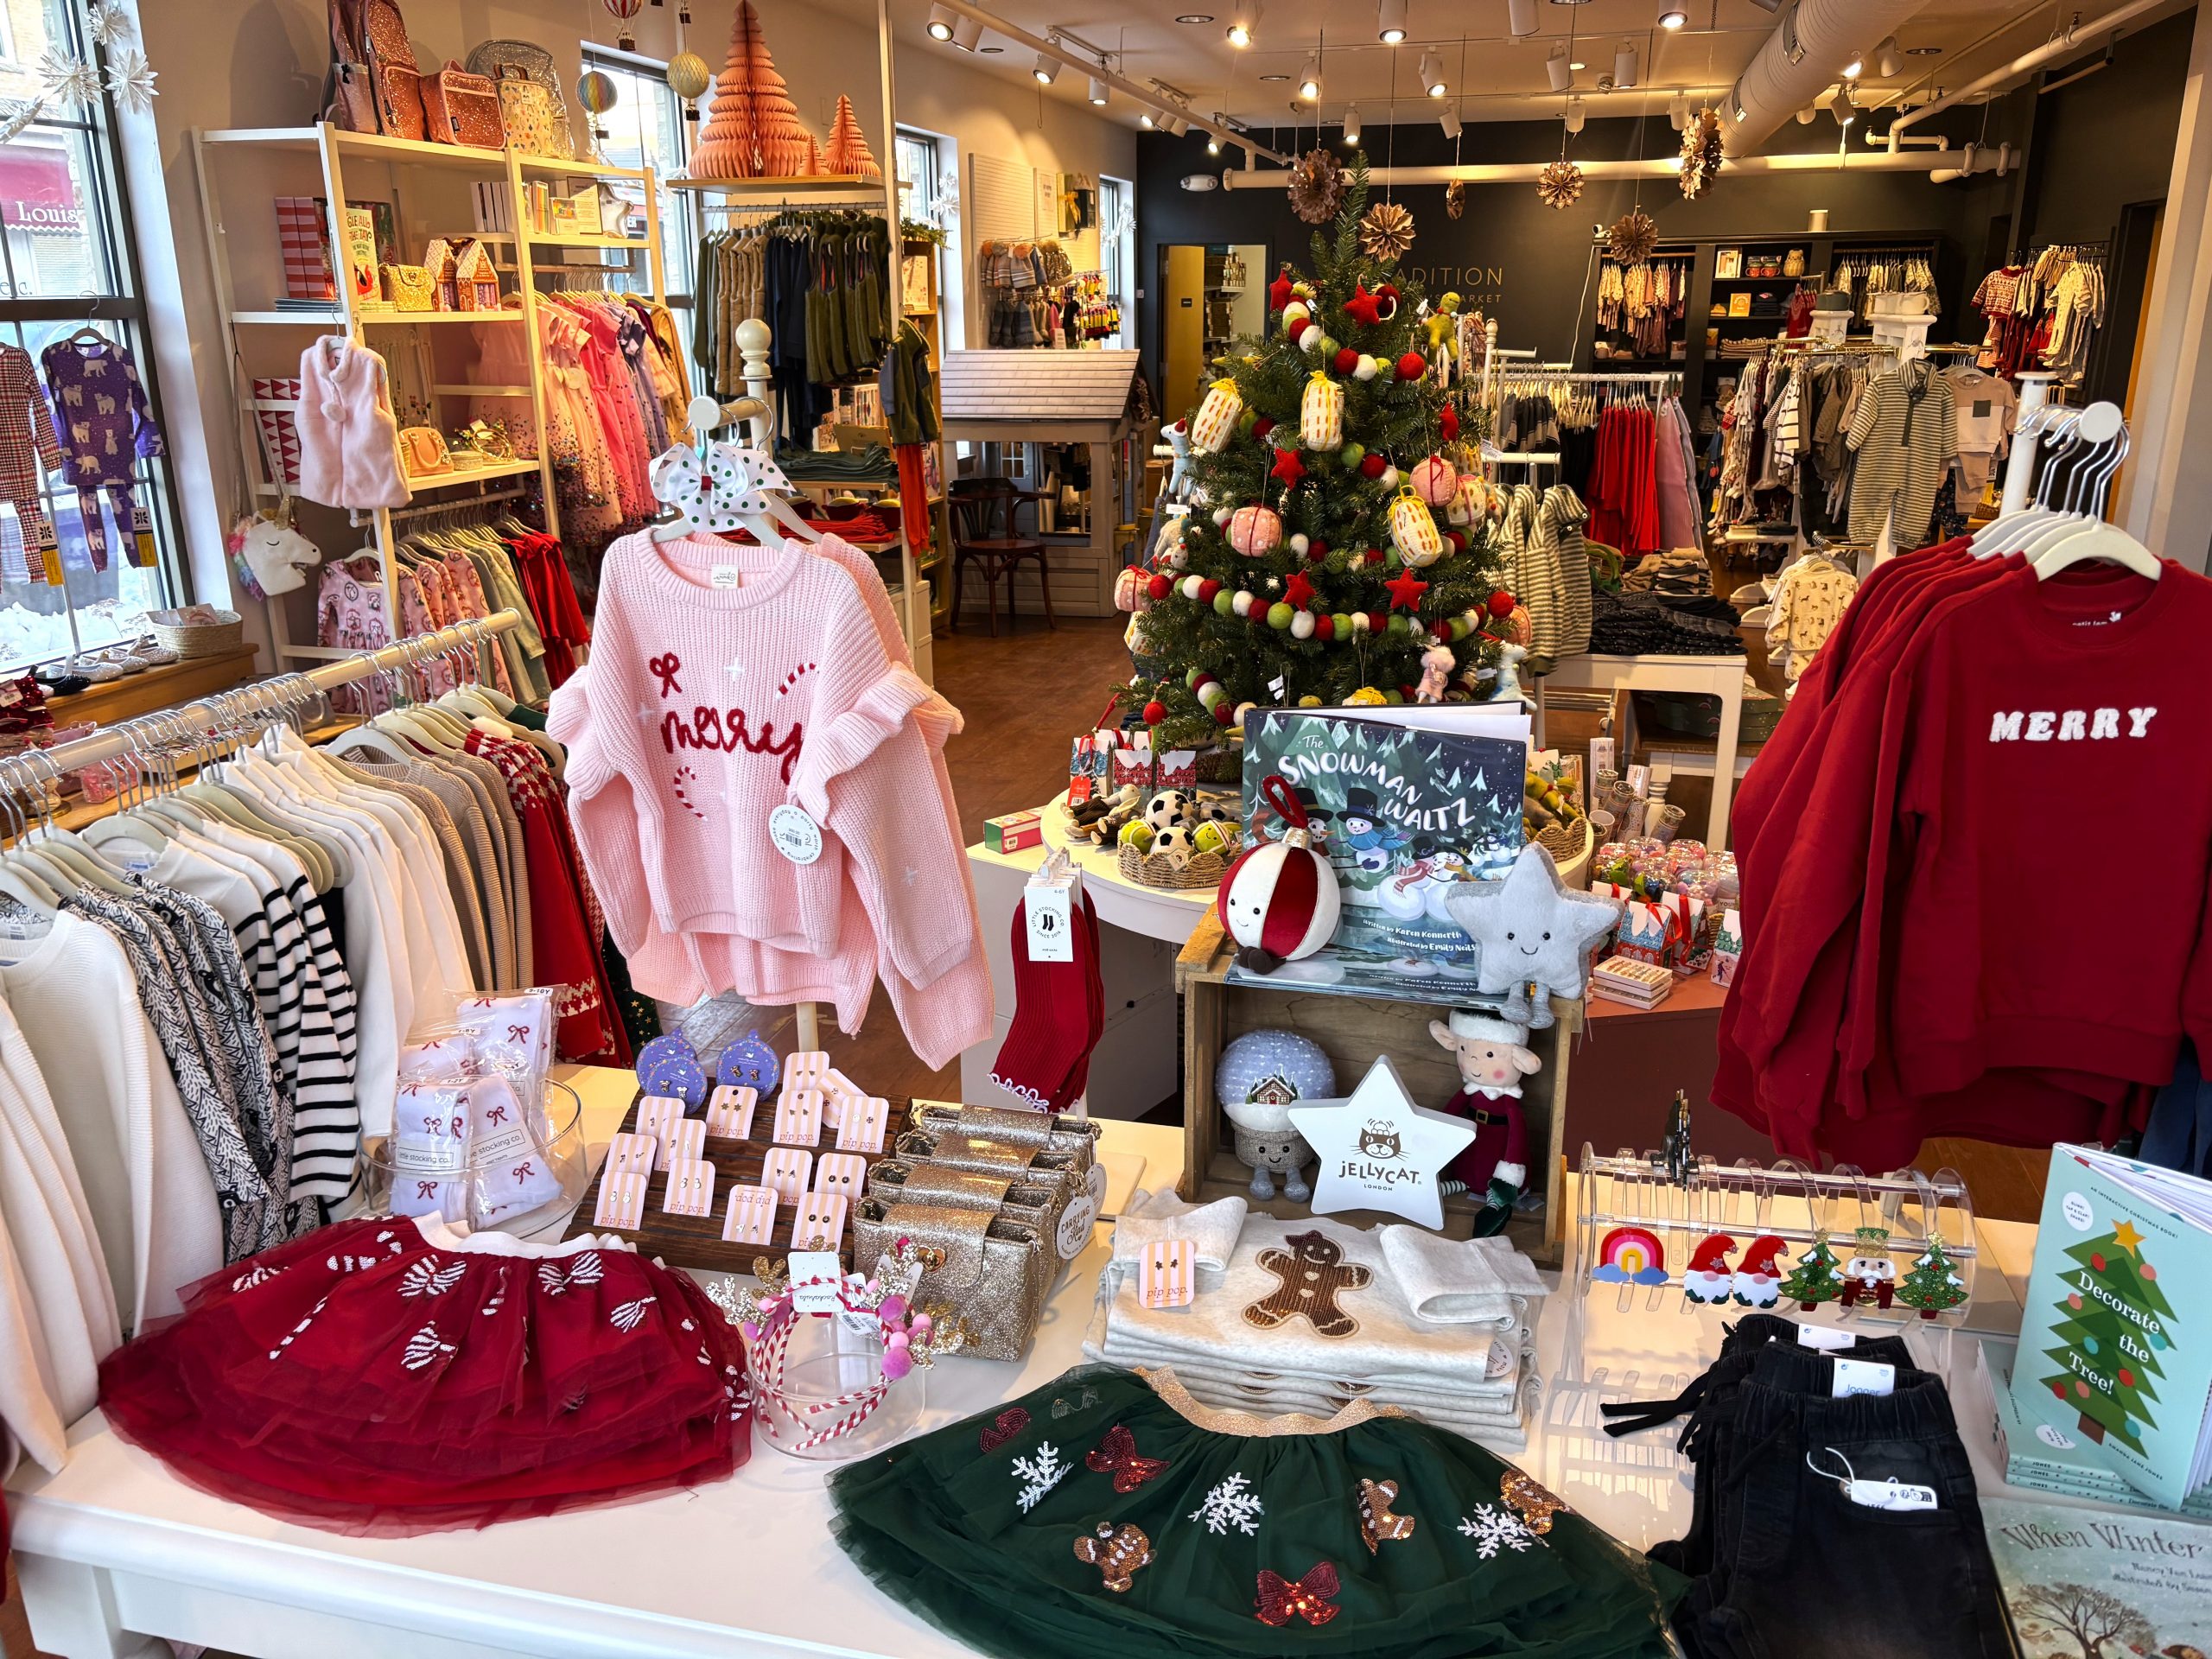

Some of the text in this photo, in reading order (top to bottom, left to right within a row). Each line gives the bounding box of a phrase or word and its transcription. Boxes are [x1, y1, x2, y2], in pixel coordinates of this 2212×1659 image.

[1395, 267, 1503, 286] ADITION
[1462, 294, 1503, 303] ARKET
[1988, 707, 2158, 743] MERRY
[661, 706, 803, 785] merry
[1302, 734, 1325, 749] The
[1278, 750, 1423, 805] SNOWMAN
[1384, 797, 1476, 831] WALTZ
[1039, 906, 1062, 918] STOCKING
[1395, 927, 1421, 938] Karen
[1429, 943, 1454, 951] Emily
[709, 1125, 725, 1135] pip
[779, 1131, 794, 1141] pip
[478, 1138, 511, 1154] stocking
[842, 1137, 856, 1147] pip
[410, 1154, 437, 1163] stocking
[669, 1201, 685, 1212] pip
[2098, 1191, 2129, 1211] INTERACTIVE
[2129, 1210, 2159, 1230] CHRISTMAS
[600, 1215, 614, 1226] pip
[1061, 1205, 1090, 1234] CARRYING
[1147, 1287, 1188, 1300] pip pop.
[2078, 1271, 2160, 1334] Decorate
[2119, 1334, 2150, 1363] the
[2069, 1351, 2113, 1395] Tree!
[2108, 1442, 2130, 1459] AMANDA
[2000, 1522, 2203, 1559] When Winter
